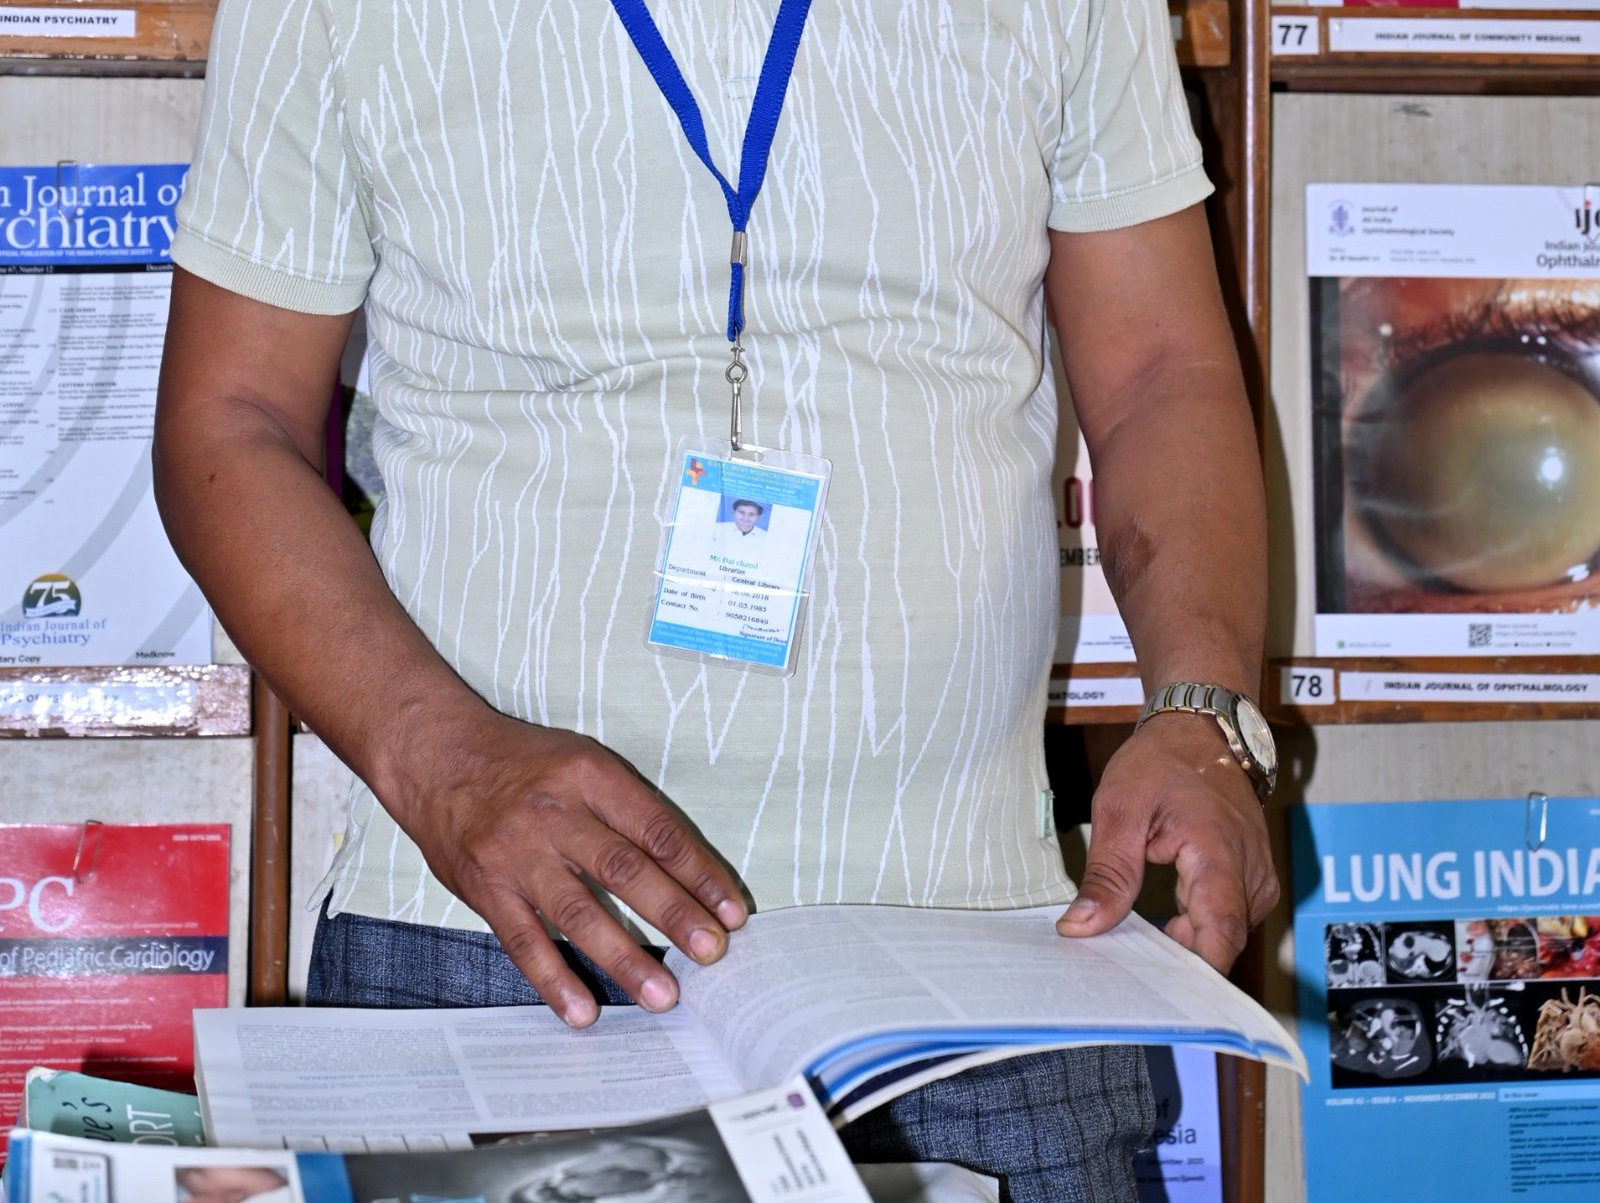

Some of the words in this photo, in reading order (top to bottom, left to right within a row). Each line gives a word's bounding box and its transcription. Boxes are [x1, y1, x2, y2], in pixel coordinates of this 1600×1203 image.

[0, 14, 40, 24] INDIAN
[44, 15, 118, 26] PSYCHIATRY
[1278, 24, 1308, 46] 77
[1375, 32, 1408, 41] INDIAN
[1412, 32, 1457, 41] JOURNAL
[1459, 33, 1471, 41] OF
[1474, 33, 1532, 42] COMMUNITY
[1535, 34, 1582, 43] MEDICINE
[19, 172, 146, 216] Journal
[1545, 240, 1580, 251] Indian
[668, 564, 706, 577] Department
[732, 577, 756, 586] Central
[719, 565, 746, 575] Librarian
[30, 580, 71, 612] 75
[664, 587, 678, 595] Date
[691, 592, 706, 601] Birth
[661, 599, 686, 609] Contact
[1, 621, 39, 632] Indian
[44, 619, 89, 632] Journal
[93, 618, 107, 630] of
[1, 633, 91, 648] Psychiatry
[19, 655, 41, 664] Copy
[136, 651, 175, 659] Medknow
[1291, 675, 1323, 697] 78
[1384, 681, 1421, 690] INDIAN
[1424, 682, 1474, 691] JOURNAL
[1477, 683, 1490, 691] OF
[1493, 683, 1589, 693] OPHTHALMOLOGY
[1323, 852, 1460, 903] LUNG
[0, 946, 19, 967] of
[23, 947, 105, 969] Pediatric
[110, 945, 215, 972] Cardiology
